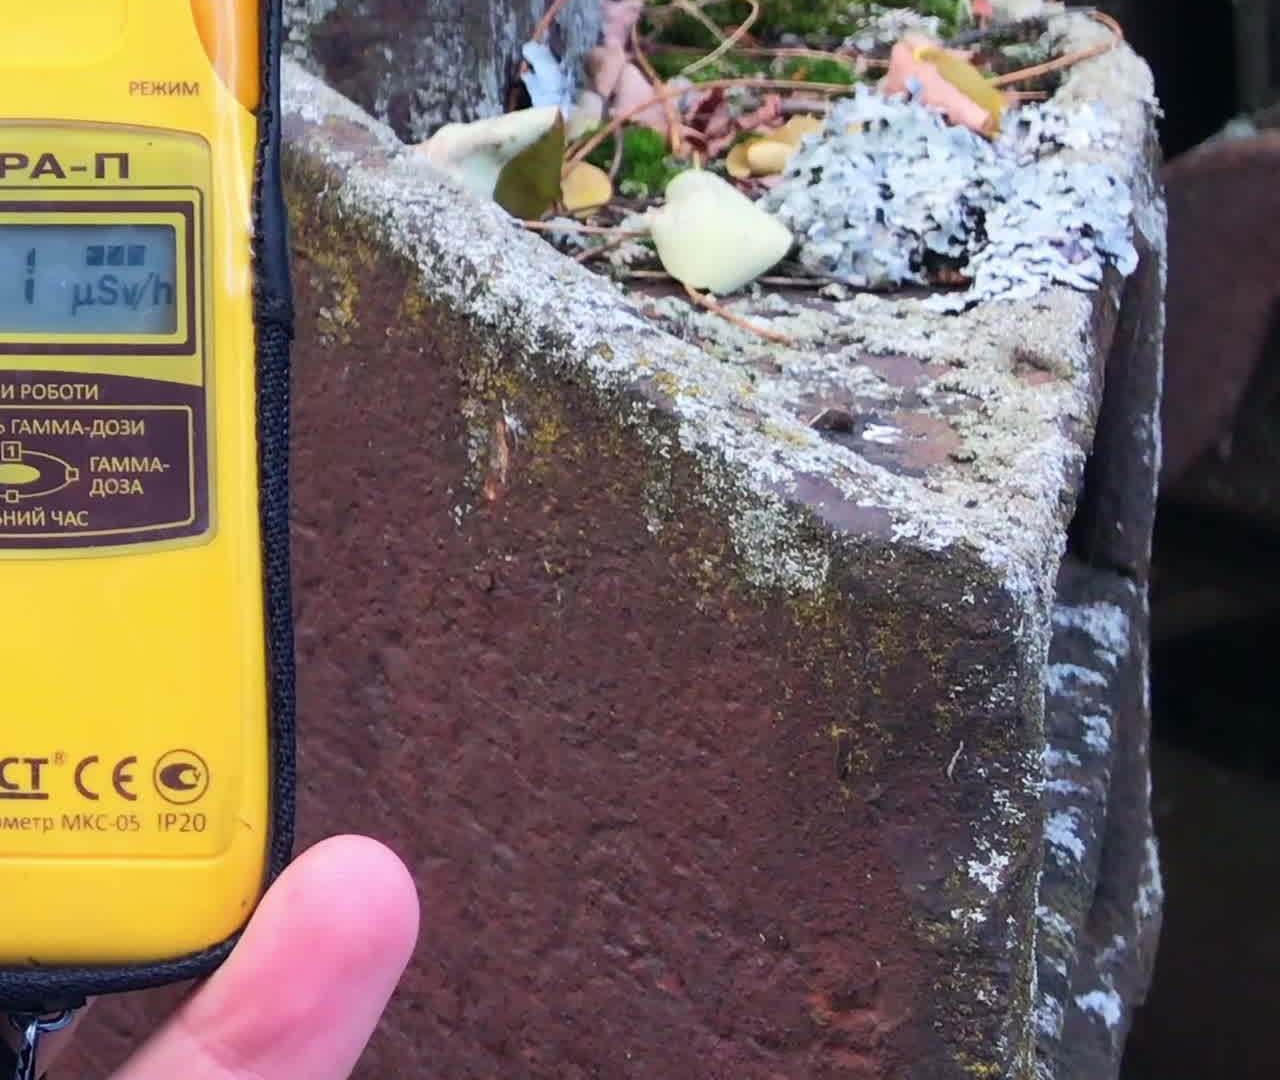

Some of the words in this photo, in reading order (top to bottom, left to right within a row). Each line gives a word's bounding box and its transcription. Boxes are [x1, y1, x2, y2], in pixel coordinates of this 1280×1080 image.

[128, 80, 200, 97] РЕЖИМ
[19, 383, 100, 401] РОБОТИ
[10, 418, 146, 439] ГАММА-ДОЗИ
[89, 455, 171, 474] ГАММА-
[88, 477, 145, 497] ДОЗА
[51, 509, 90, 528] ЧАС
[61, 813, 141, 833] МКС-05
[157, 812, 207, 833] IP20
